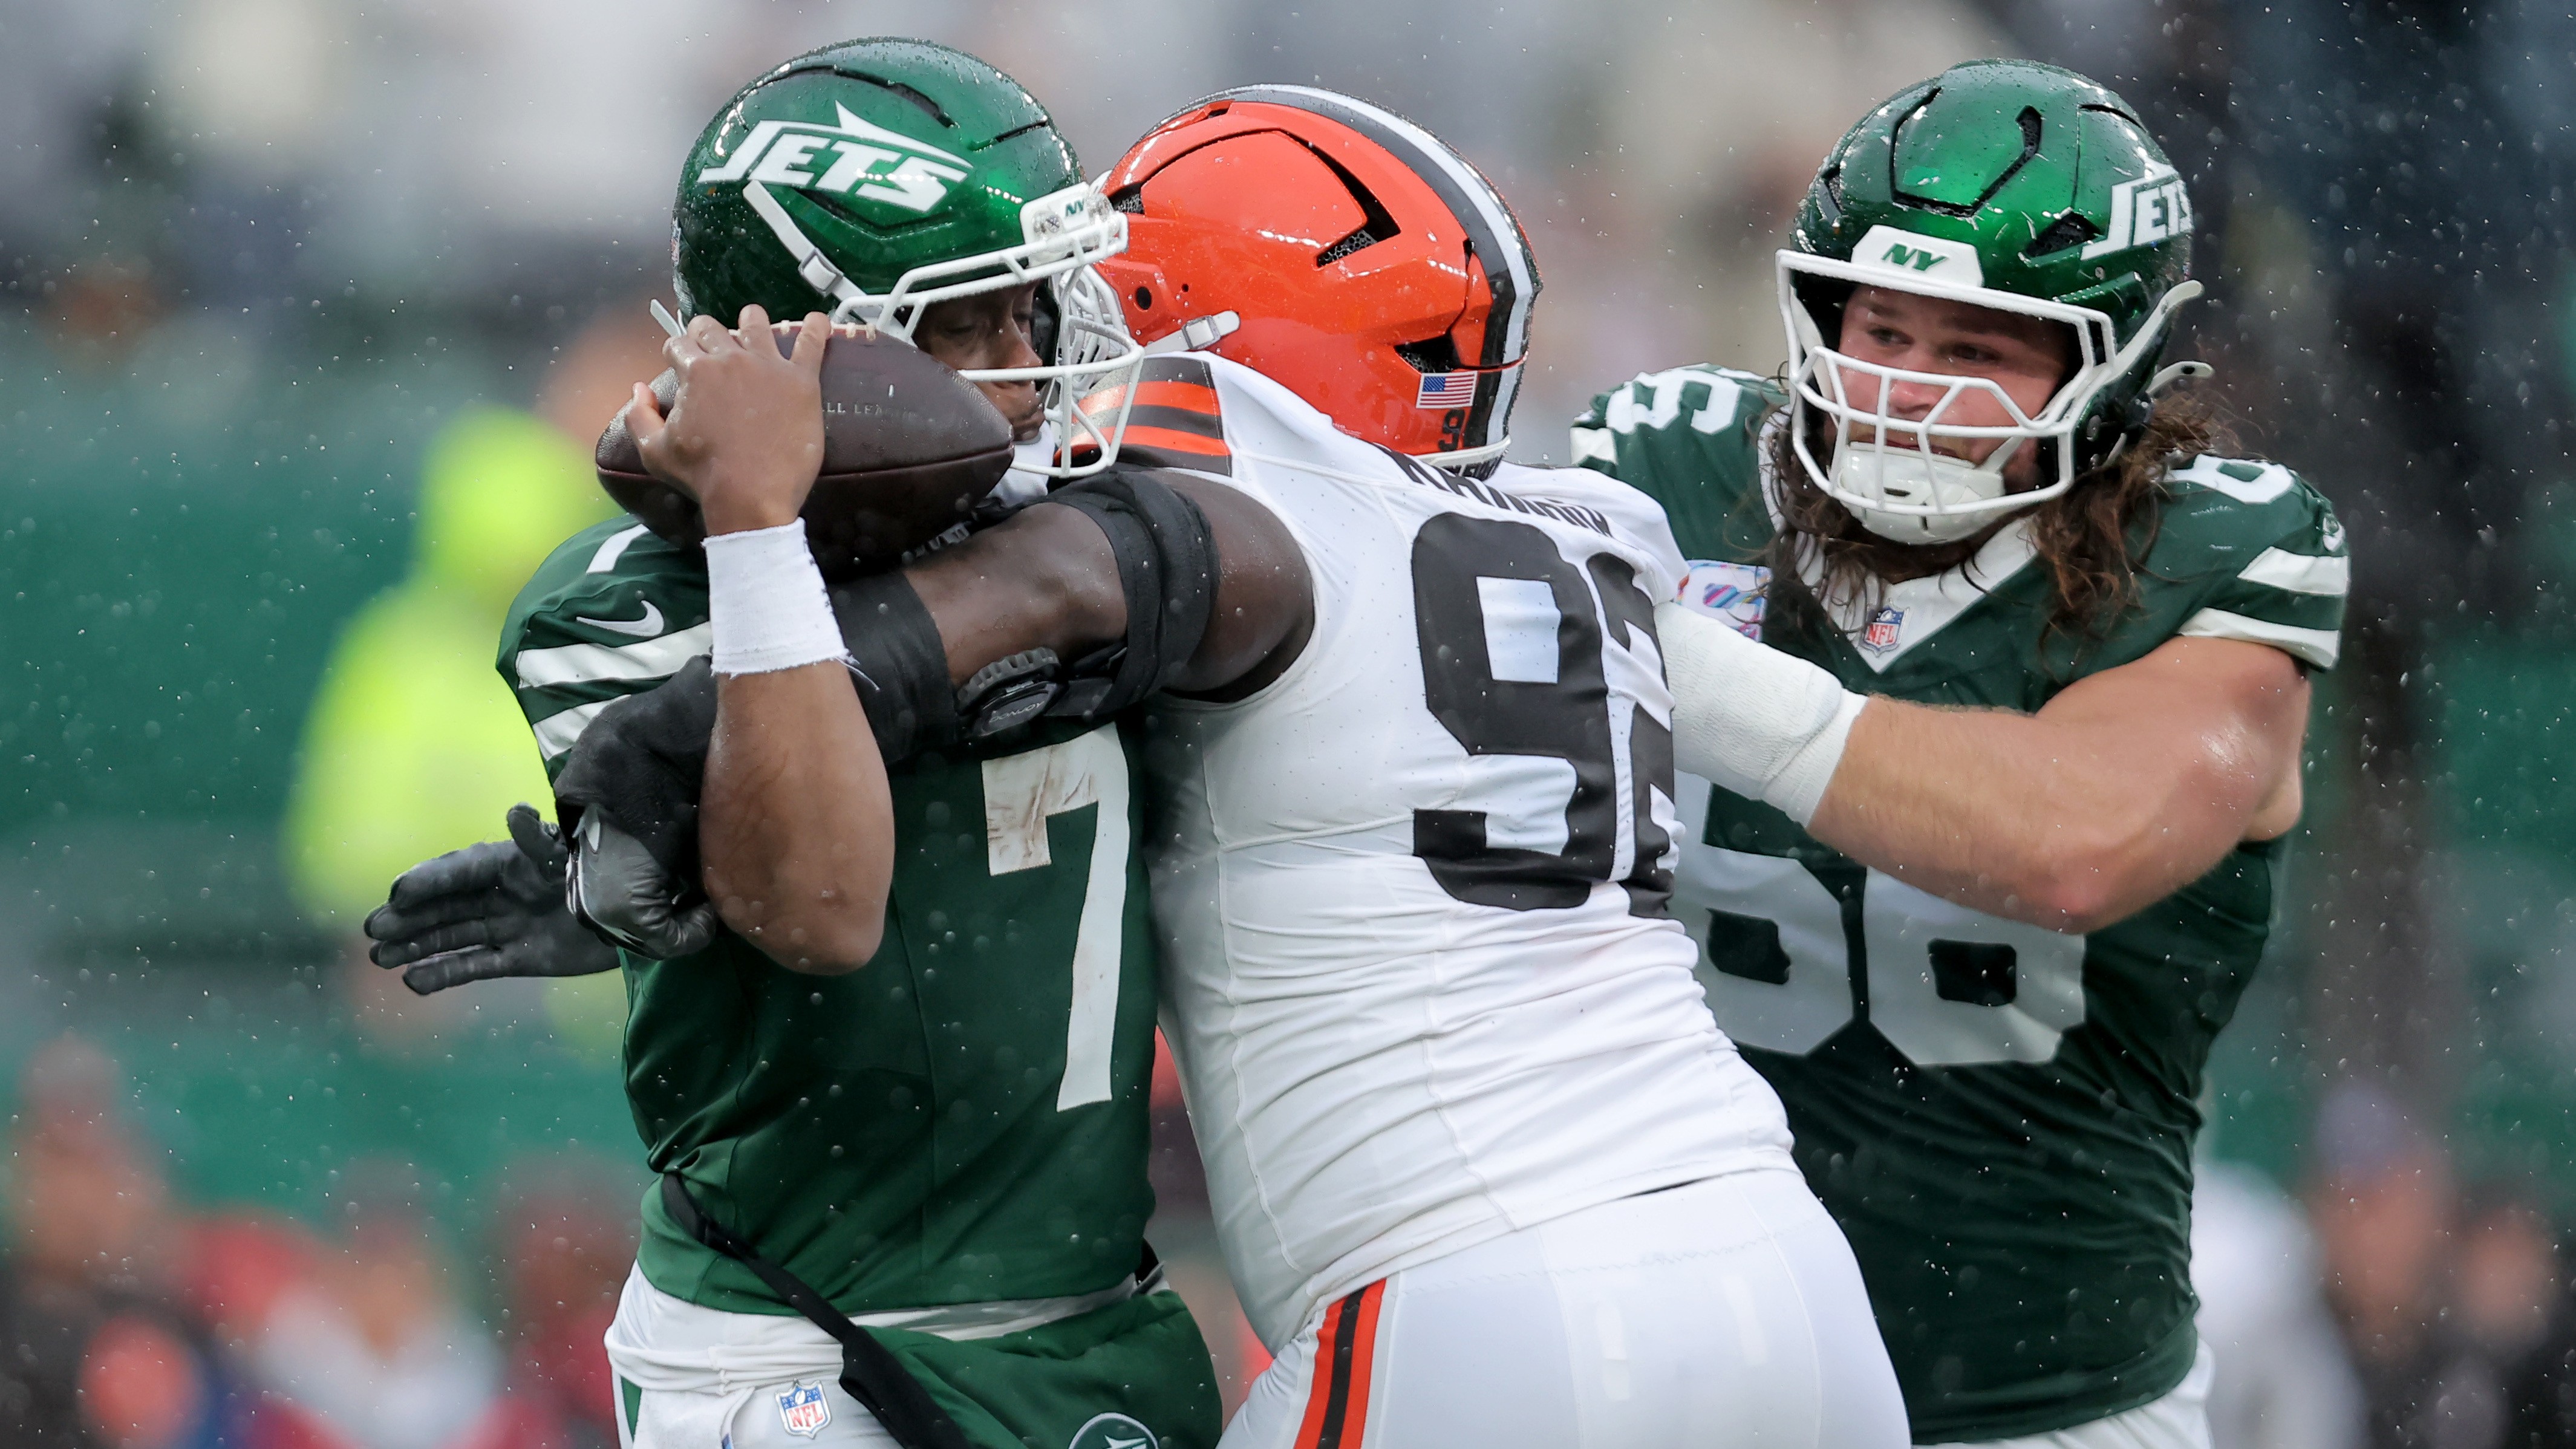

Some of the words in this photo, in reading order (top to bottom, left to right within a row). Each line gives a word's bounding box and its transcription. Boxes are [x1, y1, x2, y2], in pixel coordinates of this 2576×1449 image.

[698, 100, 973, 213] JETS
[1065, 198, 1084, 217] NY
[1881, 243, 1949, 271] NY
[1438, 409, 1465, 451] 9
[1867, 624, 1894, 645] NFL
[1411, 512, 1675, 920] 92
[981, 722, 1130, 1112] 7
[788, 1403, 823, 1427] NFL
